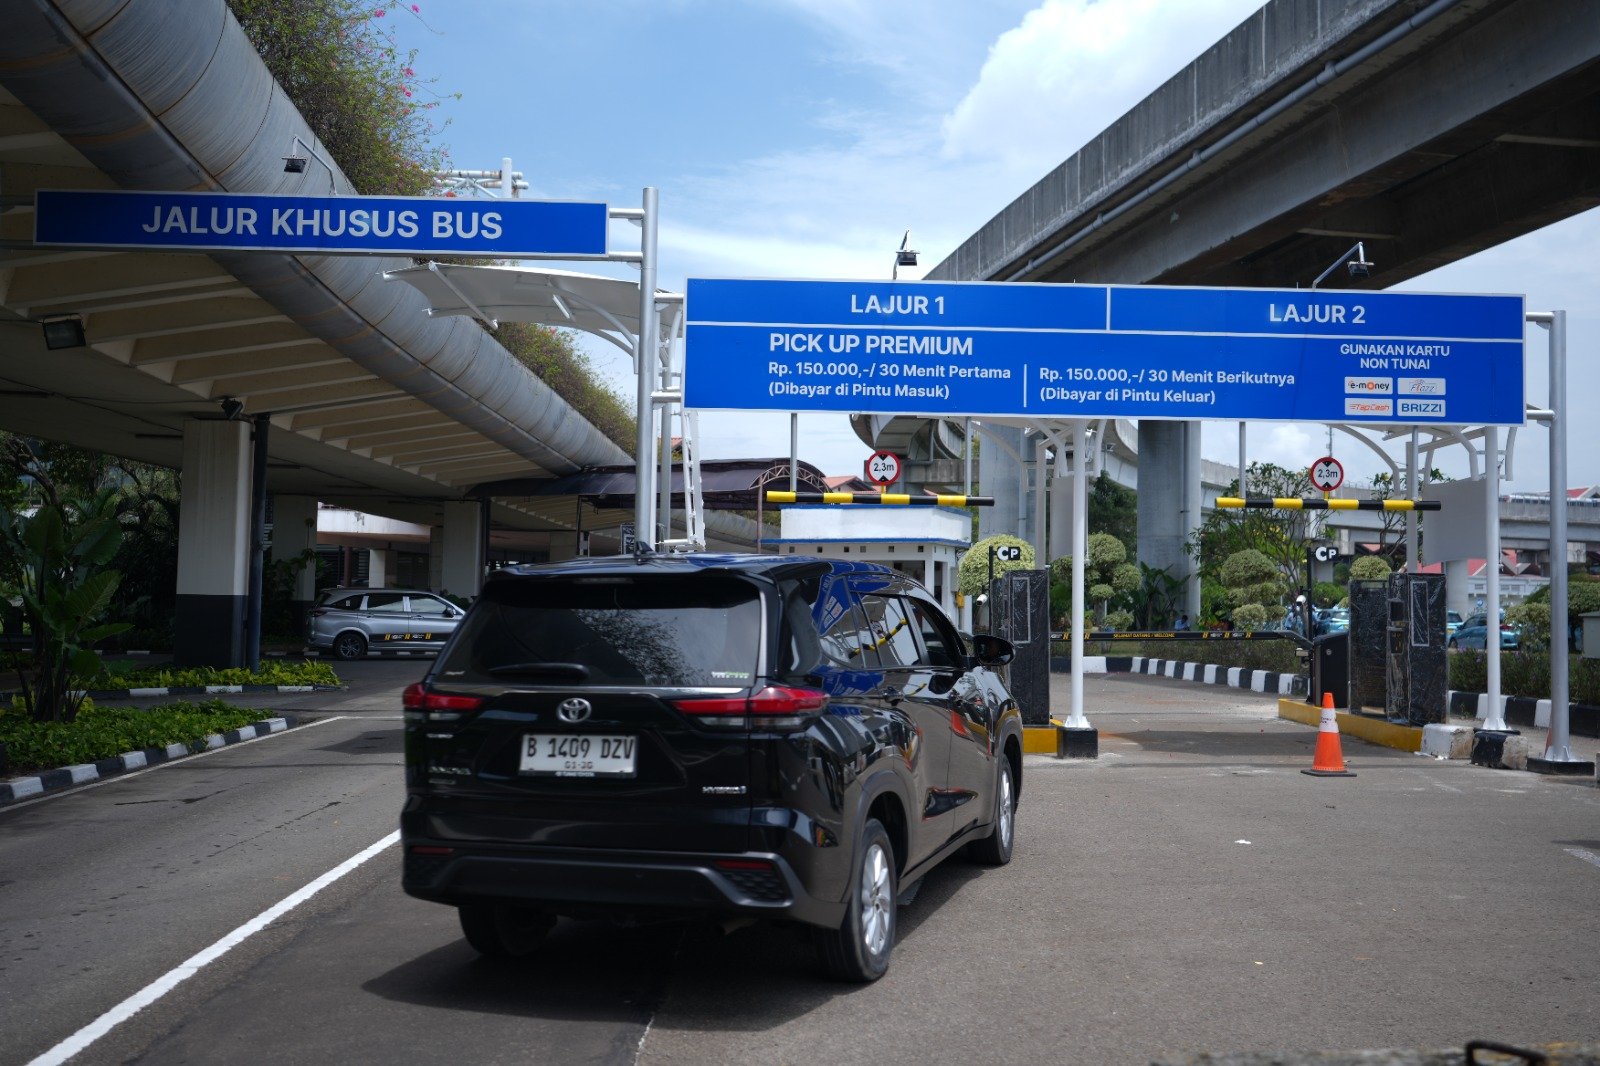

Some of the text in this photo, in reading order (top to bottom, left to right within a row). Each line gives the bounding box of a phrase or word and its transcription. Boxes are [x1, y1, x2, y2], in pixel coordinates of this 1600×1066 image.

[143, 206, 502, 239] JALUR KHUSUS BUS
[852, 295, 944, 314] LAJUR 1
[1270, 304, 1365, 323] LAJUR 2
[770, 333, 972, 355] PICK UP PREMIUM
[1341, 344, 1449, 356] GUNAKAN KARTU
[769, 362, 792, 377] Rp.
[880, 364, 899, 376] 30
[904, 365, 945, 377] Menit
[950, 366, 1010, 378] Pertama
[1361, 358, 1429, 369] NON TUNAI
[1040, 368, 1062, 382] Rp.
[1149, 370, 1167, 382] 30
[1172, 370, 1213, 382] Menit
[1217, 371, 1294, 387] Berikutnya
[1349, 380, 1390, 392] e-money
[769, 382, 949, 399] (Dibayar di Pintu Masuk)
[1040, 387, 1215, 404] (Dibayar di Pintu Keluar)
[1402, 404, 1441, 412] BRIZZI
[873, 462, 895, 472] 2.3m
[527, 736, 634, 759] B 1409 DZV
